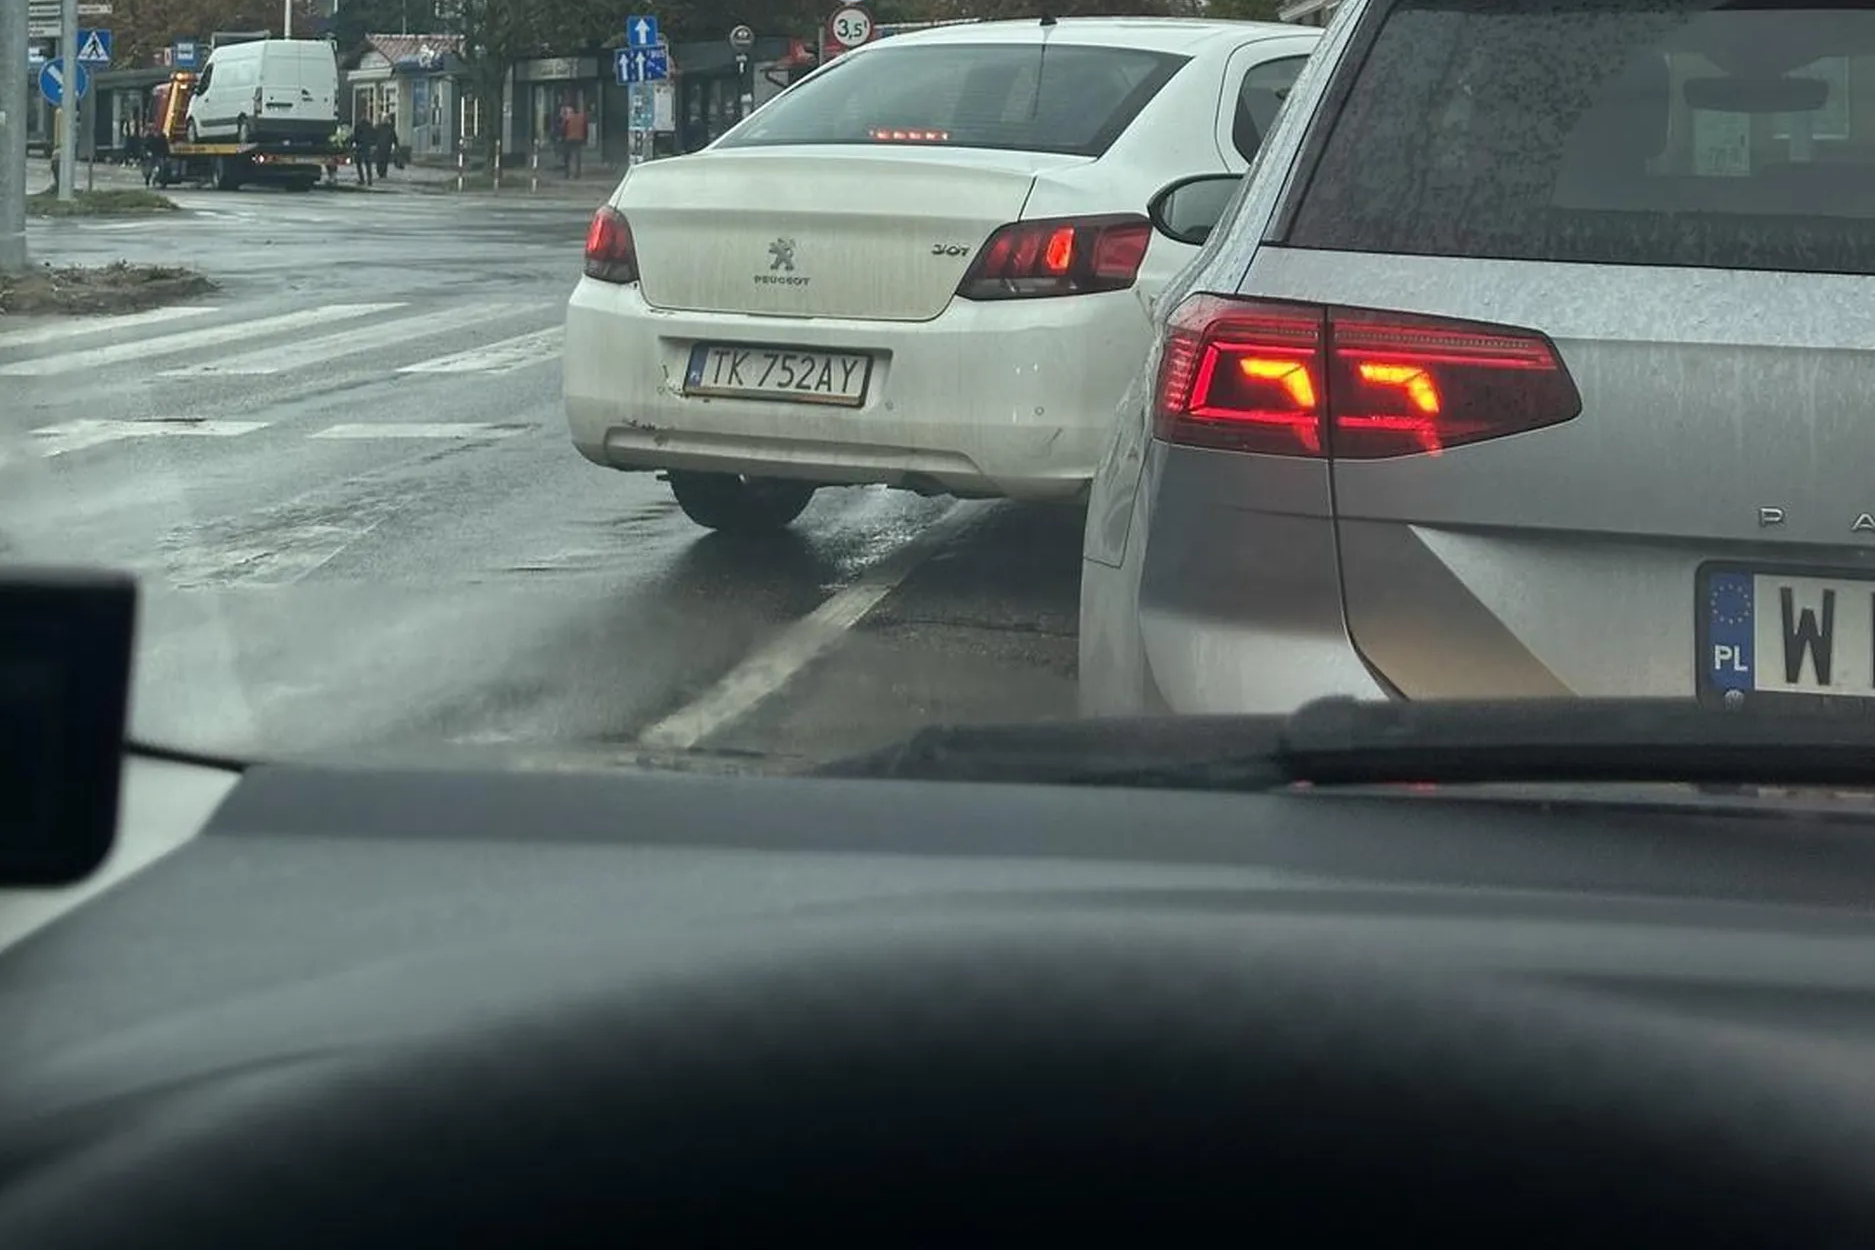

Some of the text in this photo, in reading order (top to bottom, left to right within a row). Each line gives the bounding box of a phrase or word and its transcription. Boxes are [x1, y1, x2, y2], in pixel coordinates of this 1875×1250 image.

[754, 274, 811, 286] PEUGEOT
[713, 350, 858, 393] TK 752AY
[1713, 644, 1749, 672] PL
